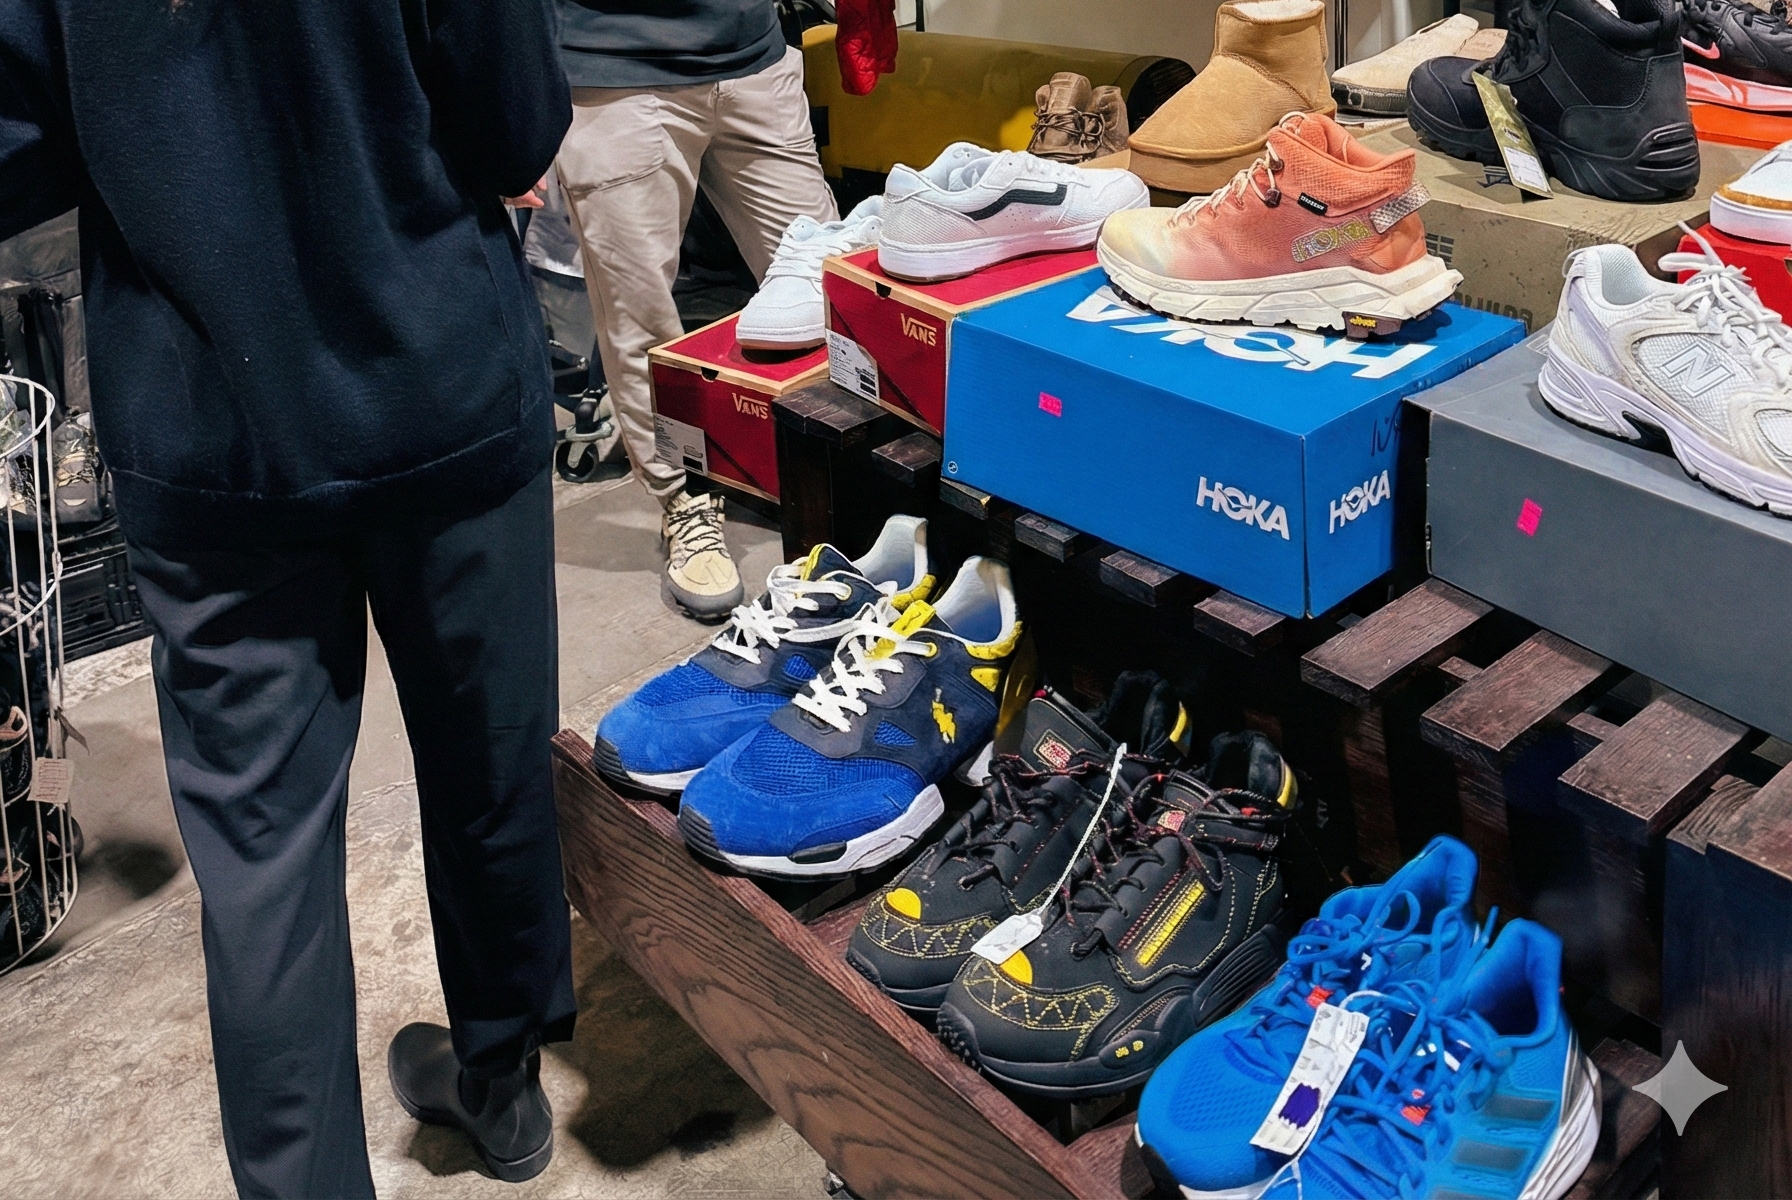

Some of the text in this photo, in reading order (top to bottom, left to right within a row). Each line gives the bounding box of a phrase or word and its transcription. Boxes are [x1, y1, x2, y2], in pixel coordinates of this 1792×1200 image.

[900, 312, 938, 347] VANS
[731, 392, 769, 420] VANS
[1196, 475, 1290, 541] HOKA
[1328, 469, 1391, 535] HOKA
